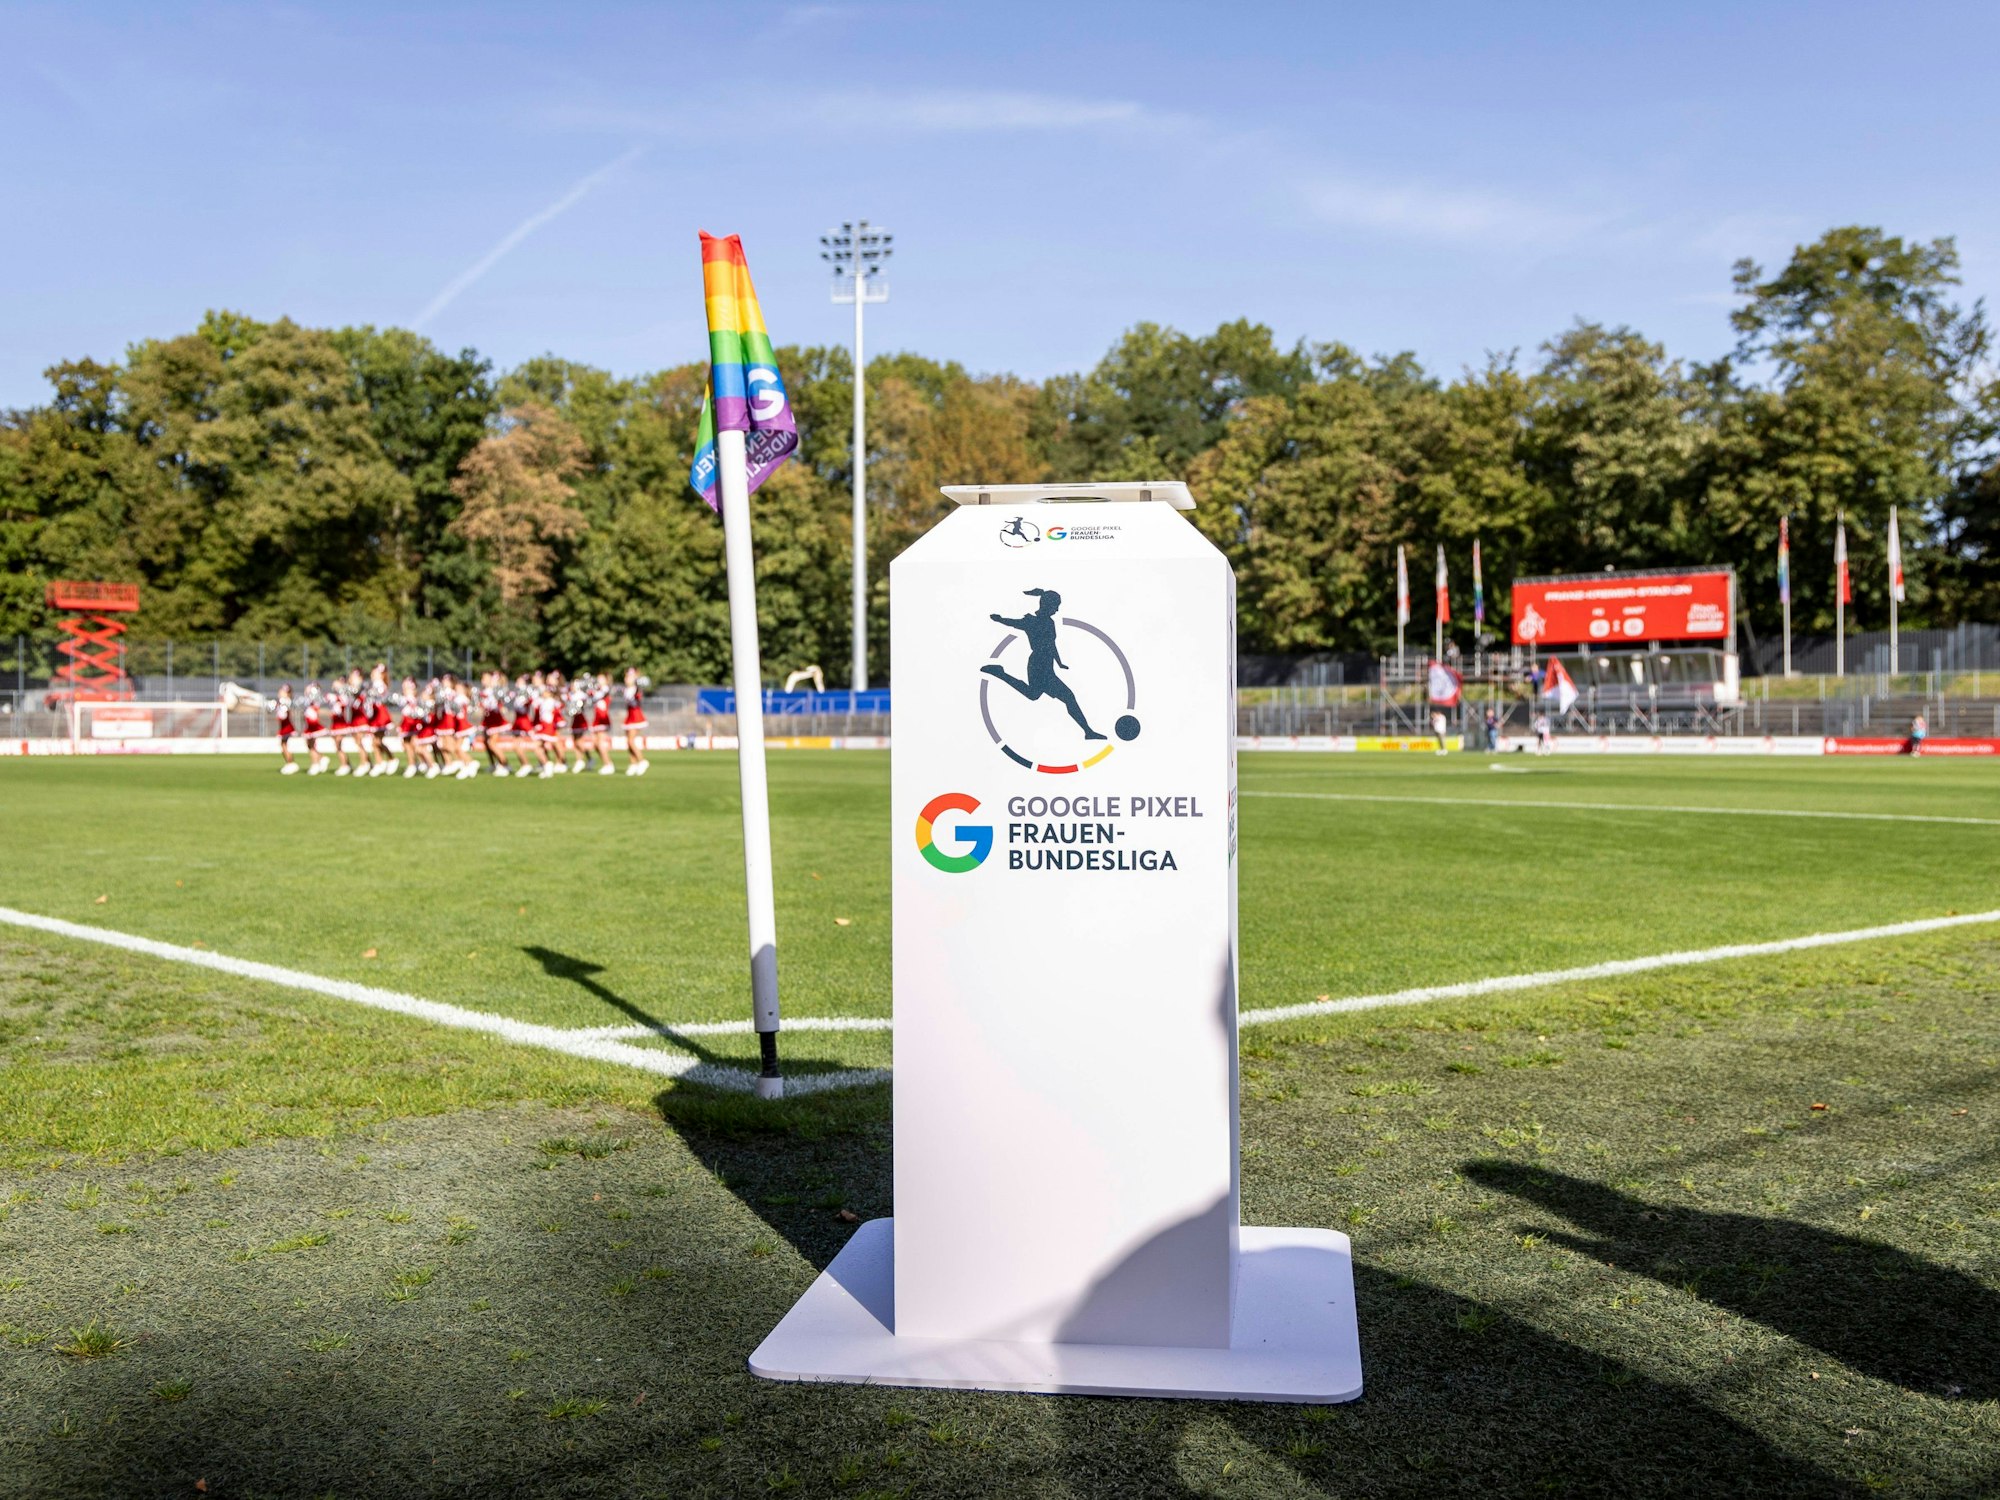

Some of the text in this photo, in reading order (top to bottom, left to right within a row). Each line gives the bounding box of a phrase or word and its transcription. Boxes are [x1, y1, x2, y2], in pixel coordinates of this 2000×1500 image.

[1008, 797, 1204, 818] GOOGLE PIXEL
[1009, 823, 1125, 844] FRAUEN-
[1009, 850, 1178, 871] BUNDESLIGA
